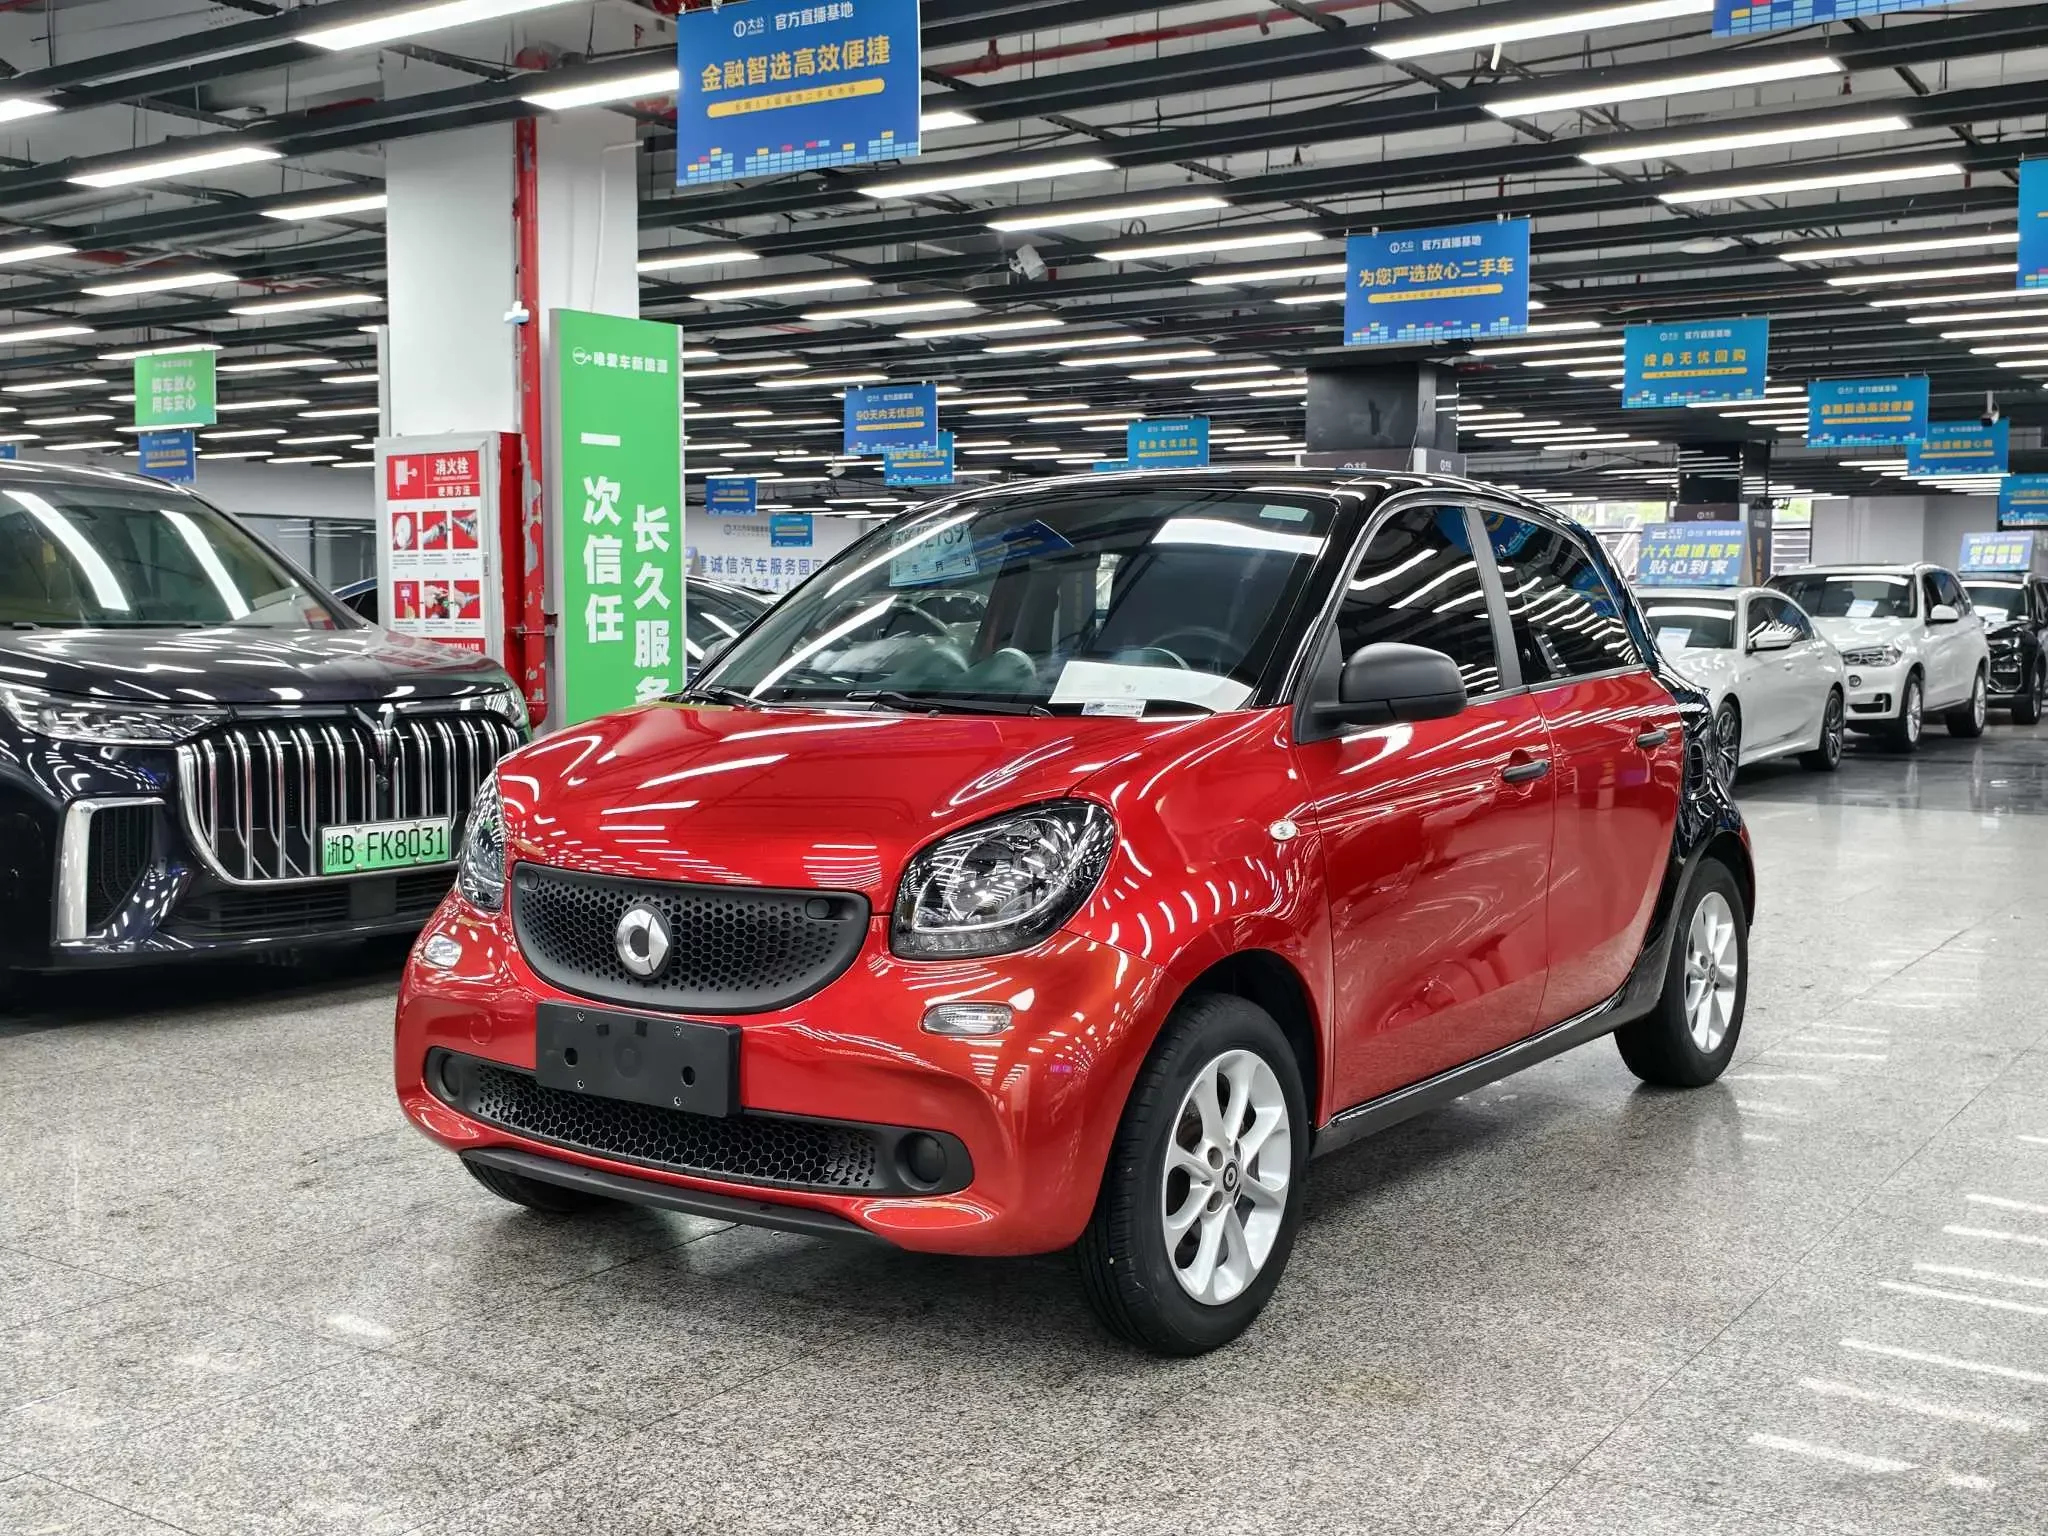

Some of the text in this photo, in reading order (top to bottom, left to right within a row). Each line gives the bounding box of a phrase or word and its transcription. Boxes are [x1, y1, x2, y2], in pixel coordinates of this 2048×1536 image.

[775, 2, 854, 31] 官方直播基地
[701, 34, 890, 93] 金融智选高效便捷
[1422, 235, 1482, 251] 官方直播基地
[1359, 256, 1514, 288] 为您严选放心二手车
[435, 457, 469, 475] 消火栓
[581, 432, 625, 643] 一次信任
[1649, 559, 1729, 575] 贴心到家
[327, 826, 445, 866] 浙B FK8031
